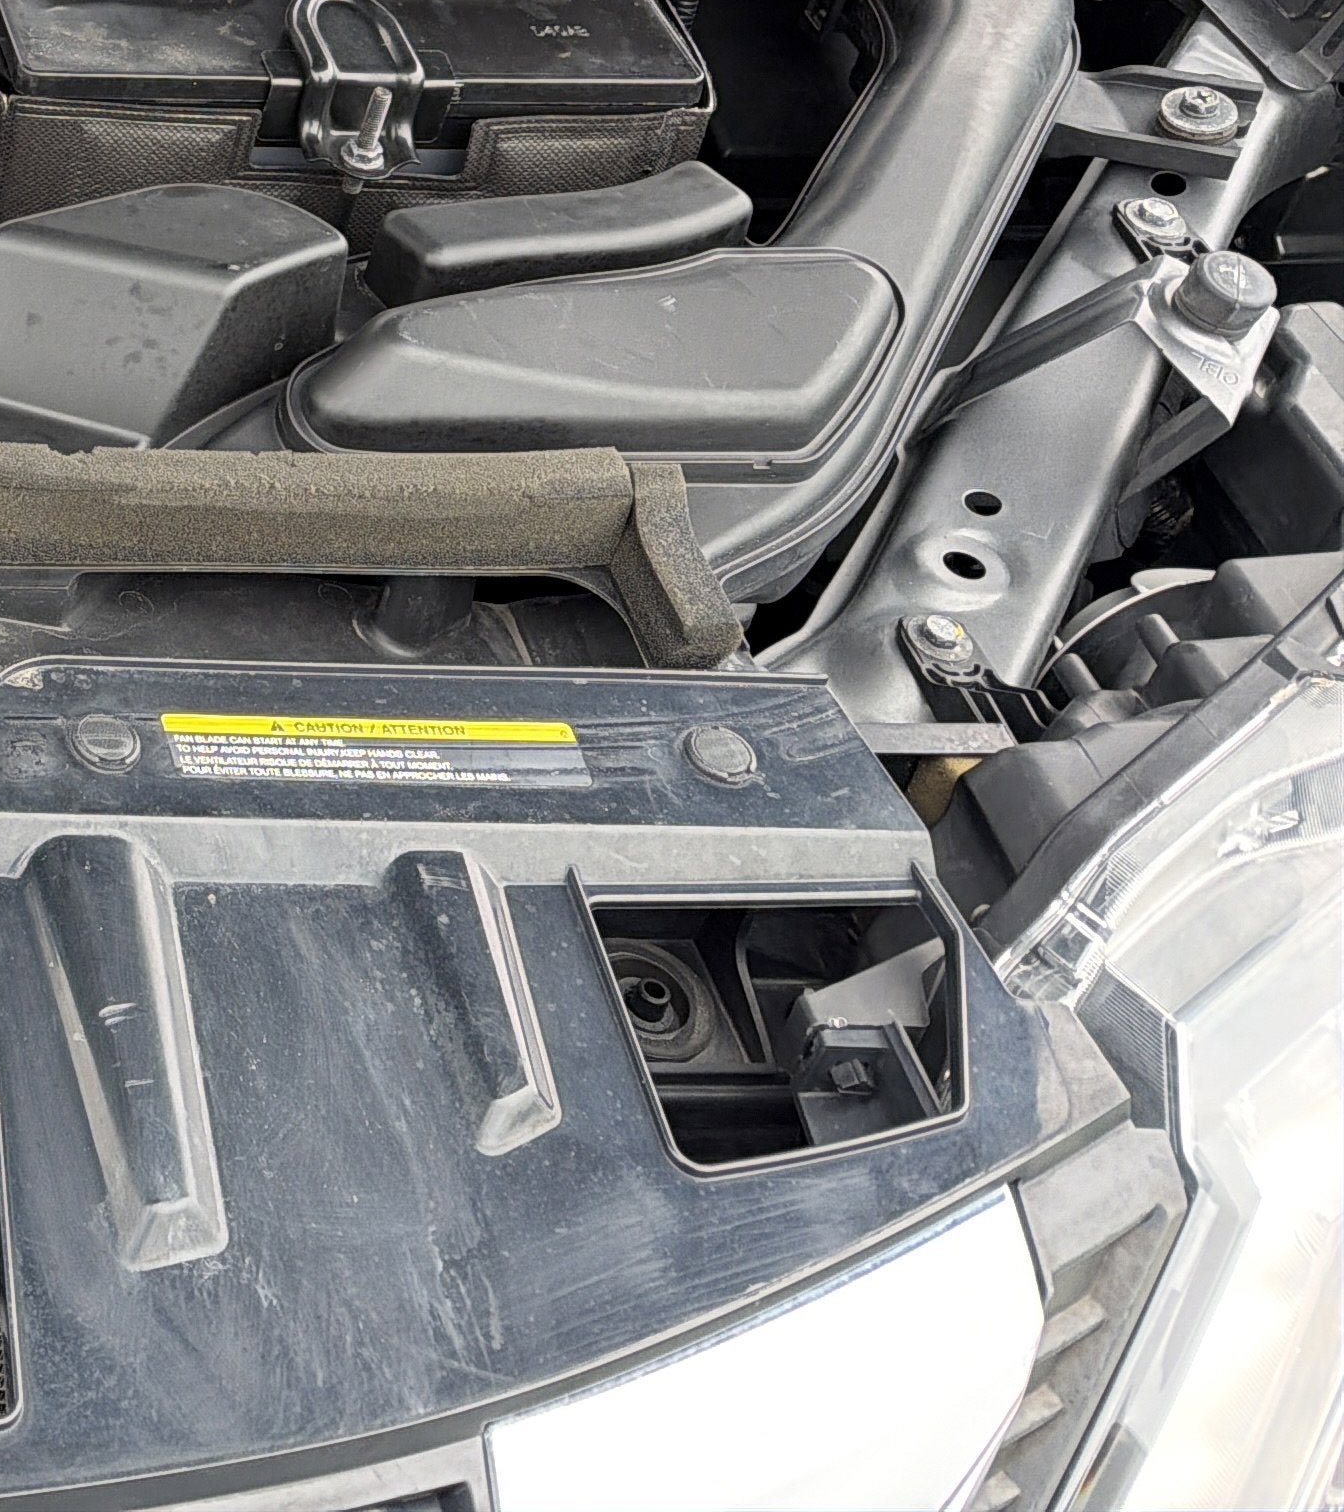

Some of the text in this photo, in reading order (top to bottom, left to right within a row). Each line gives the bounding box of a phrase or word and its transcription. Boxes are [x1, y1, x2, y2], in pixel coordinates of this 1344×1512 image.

[294, 721, 363, 734] CAUTION
[382, 723, 466, 736] ATTENTION
[174, 735, 193, 744] FAN
[195, 735, 227, 745] BLADE
[229, 736, 251, 745] CAN
[253, 736, 283, 746] START
[299, 737, 319, 746] ANY
[176, 744, 190, 753] TO
[192, 745, 219, 754] HELP
[221, 746, 251, 755] AVOID
[252, 746, 305, 757] PERSONAL
[367, 750, 403, 759] HANDS
[180, 755, 193, 765] LE
[194, 756, 258, 766] VENTILATEUR
[260, 758, 297, 767] RISQUE
[298, 759, 313, 768] DE
[381, 761, 406, 770] TOUT
[182, 766, 212, 775] POUR
[249, 767, 281, 777] TOUTE
[355, 770, 376, 779] PAS
[393, 771, 456, 781] APPROCHER
